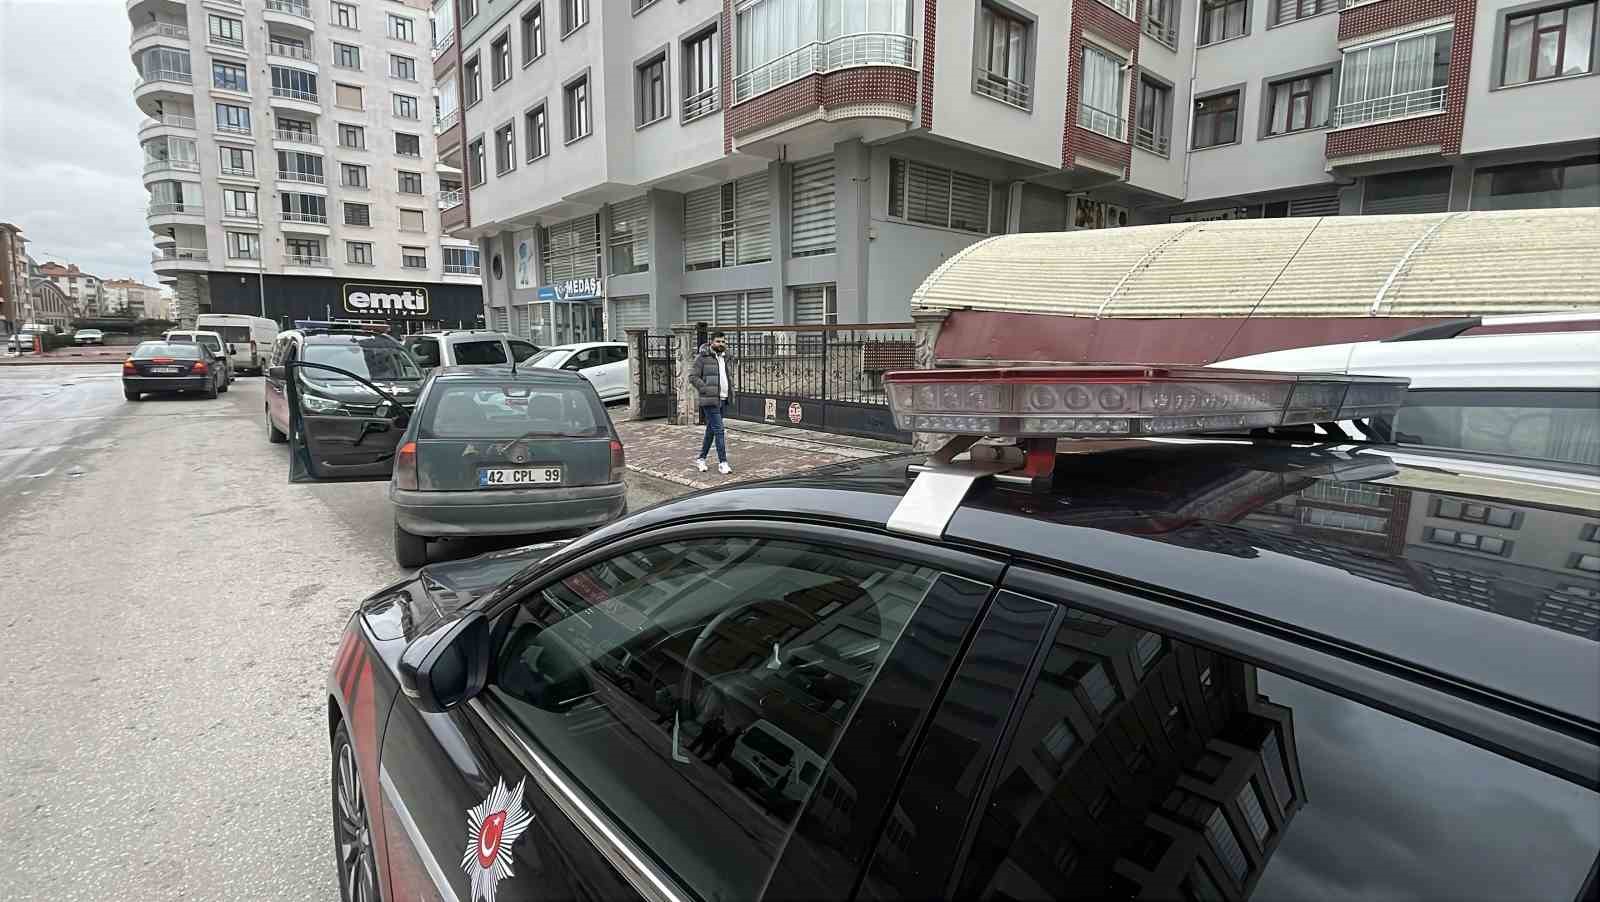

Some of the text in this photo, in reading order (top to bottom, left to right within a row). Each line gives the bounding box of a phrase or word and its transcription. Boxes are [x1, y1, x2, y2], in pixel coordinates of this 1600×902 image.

[567, 278, 596, 295] MEDAŞ
[348, 288, 425, 310] emti
[488, 470, 505, 483] 42
[513, 469, 536, 482] CPL
[544, 469, 560, 482] 99
